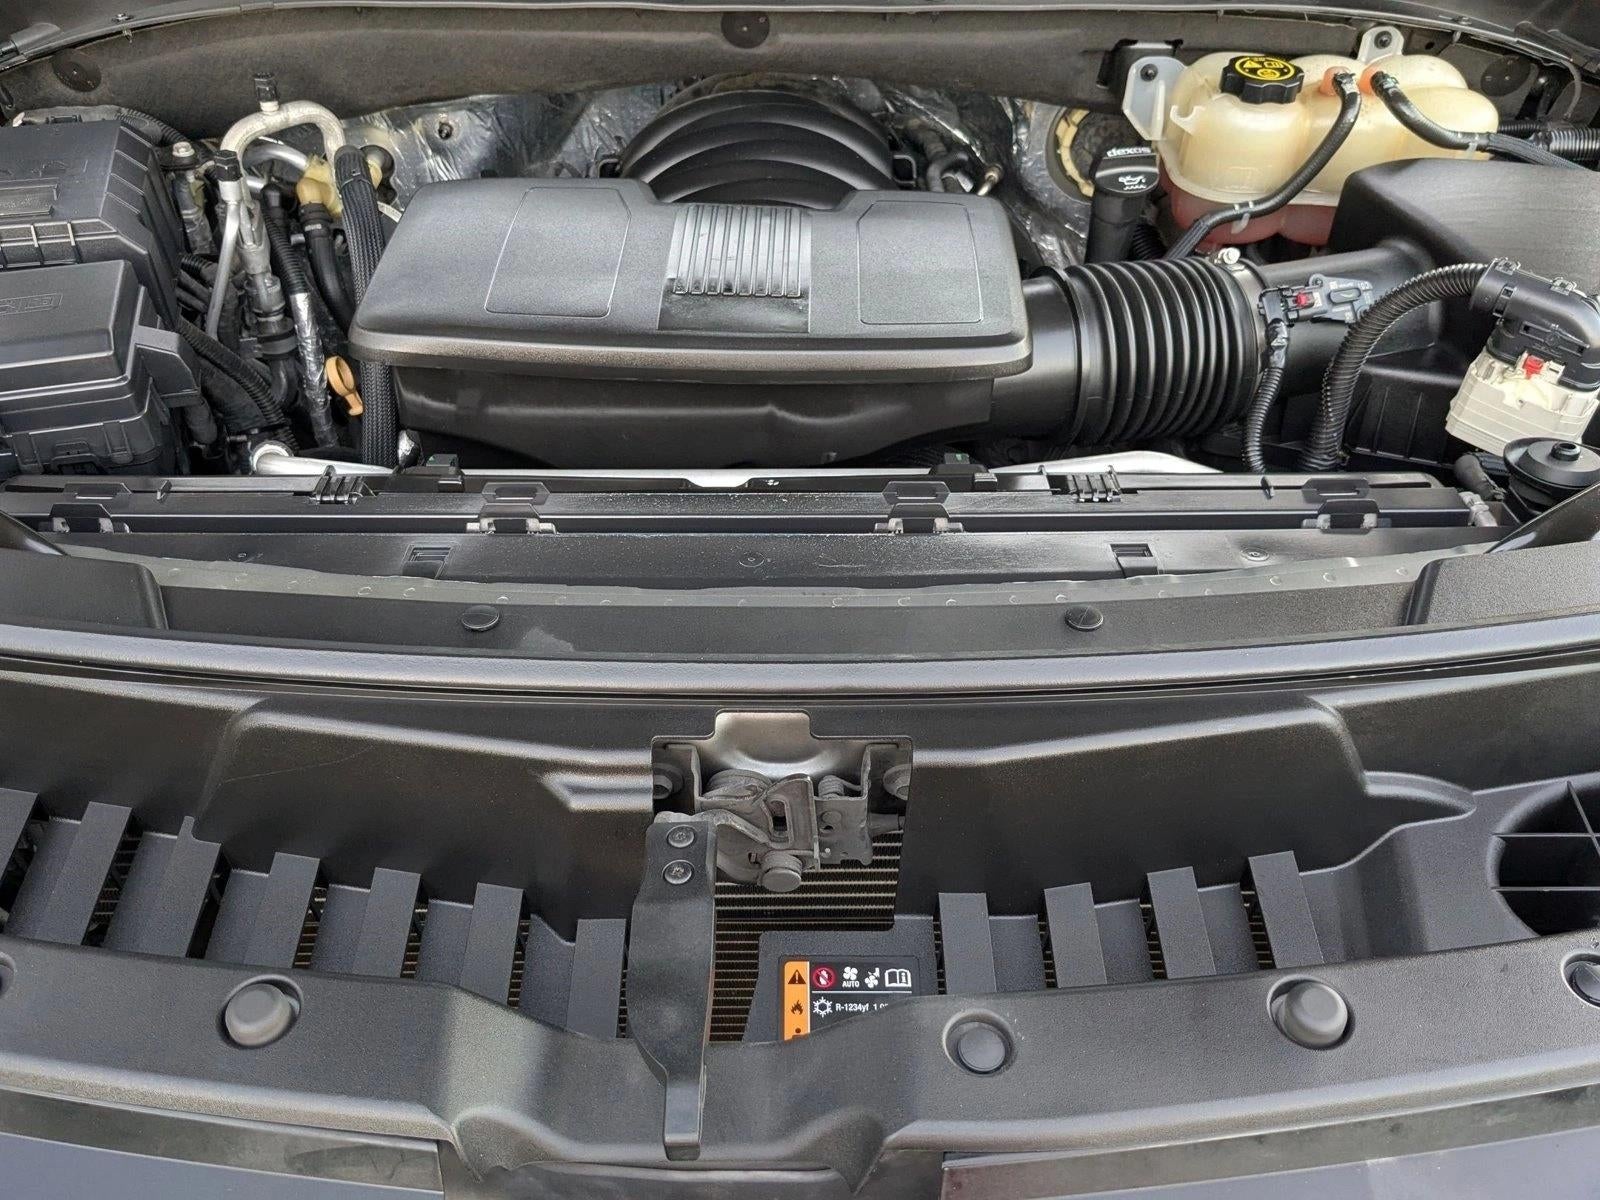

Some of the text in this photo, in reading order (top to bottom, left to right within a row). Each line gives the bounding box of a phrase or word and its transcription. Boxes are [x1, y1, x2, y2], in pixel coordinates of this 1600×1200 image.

[1106, 147, 1151, 157] dexos
[842, 980, 860, 988] AUTO
[835, 1003, 869, 1012] R-1234yf
